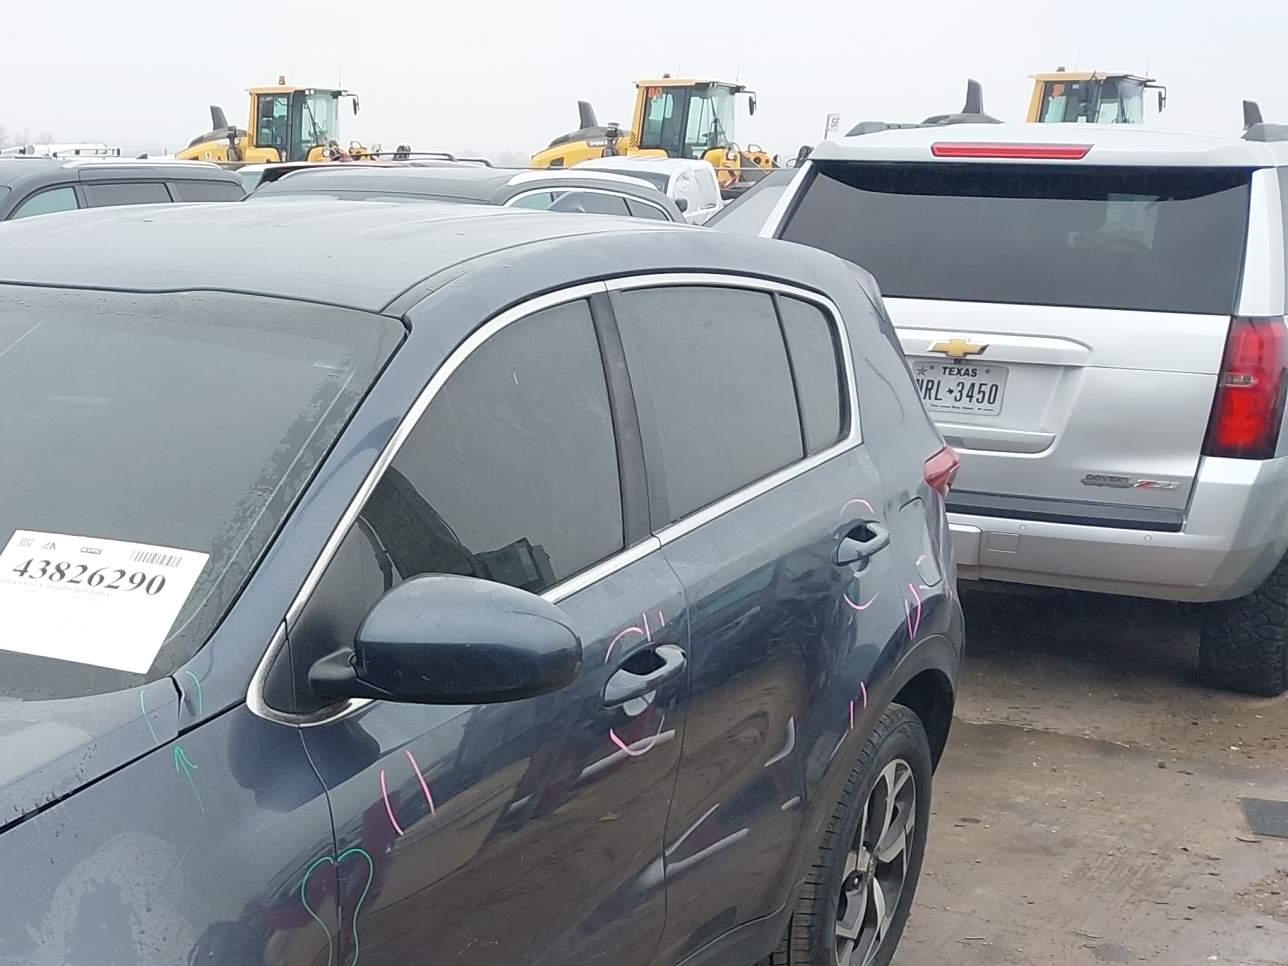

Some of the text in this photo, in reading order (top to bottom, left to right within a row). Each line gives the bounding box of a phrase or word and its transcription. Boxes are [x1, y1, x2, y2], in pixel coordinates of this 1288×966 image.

[942, 366, 978, 377] TEXAS
[954, 381, 999, 405] 3450
[12, 558, 166, 596] 43826290
